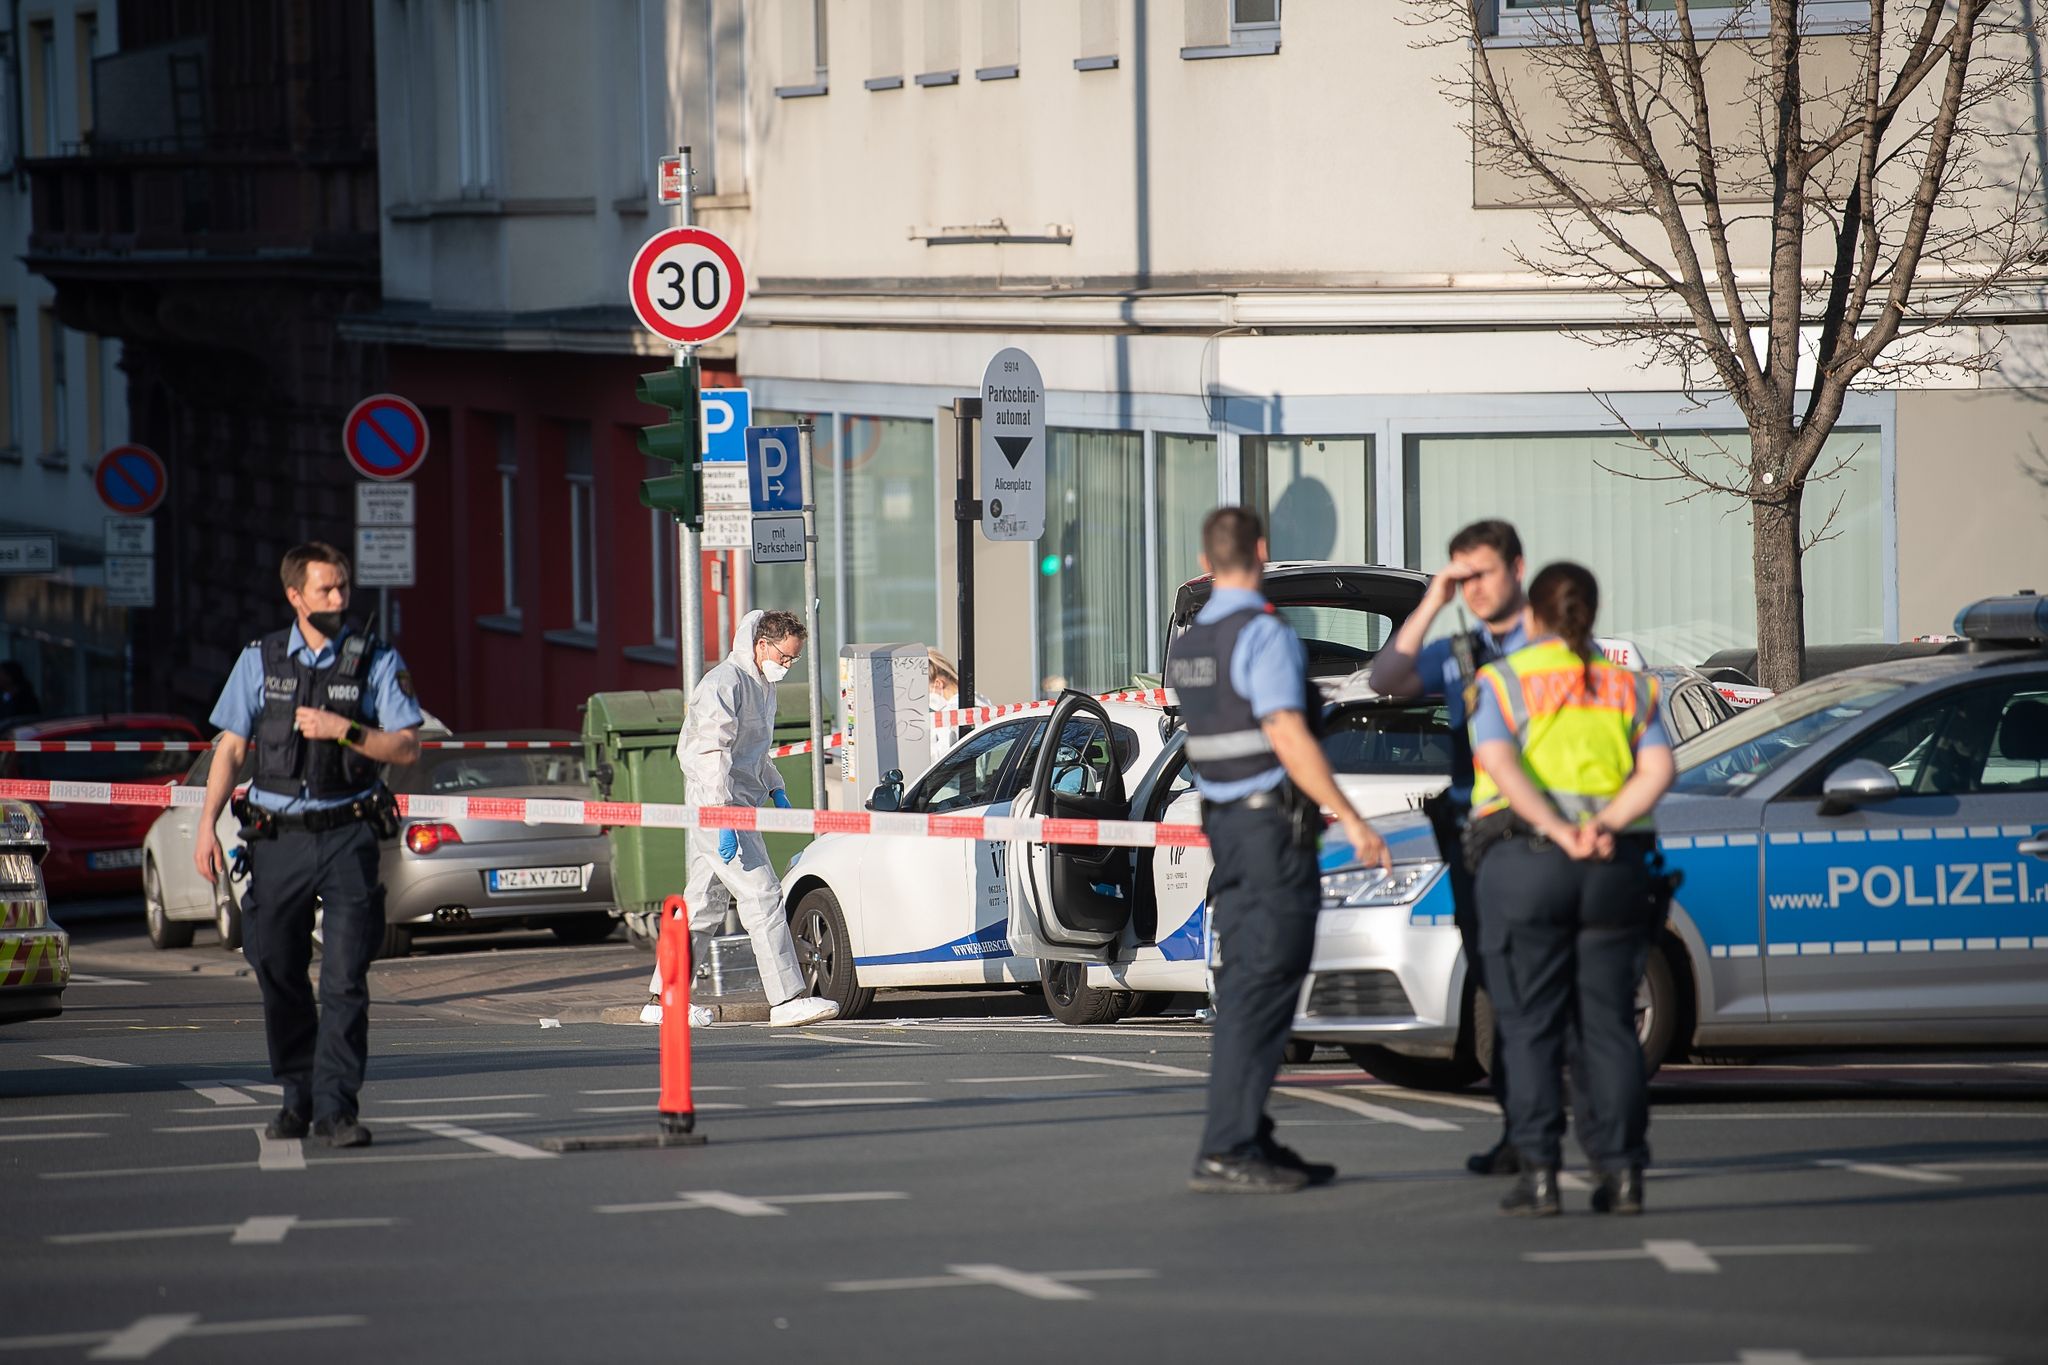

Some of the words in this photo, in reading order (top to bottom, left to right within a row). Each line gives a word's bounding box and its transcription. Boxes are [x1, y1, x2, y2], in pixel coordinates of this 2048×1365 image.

[657, 261, 720, 310] 30
[1004, 361, 1019, 372] 9914
[988, 385, 1040, 403] Parkschein-
[996, 409, 1031, 425] automat
[701, 400, 735, 455] P
[759, 438, 788, 501] P
[995, 478, 1032, 493] Alicenplatz
[772, 526, 786, 540] mit
[757, 541, 802, 554] Parkschein
[327, 684, 360, 701] VIDEO
[499, 871, 517, 886] MZ
[529, 871, 547, 885] XY
[551, 869, 577, 884] 707
